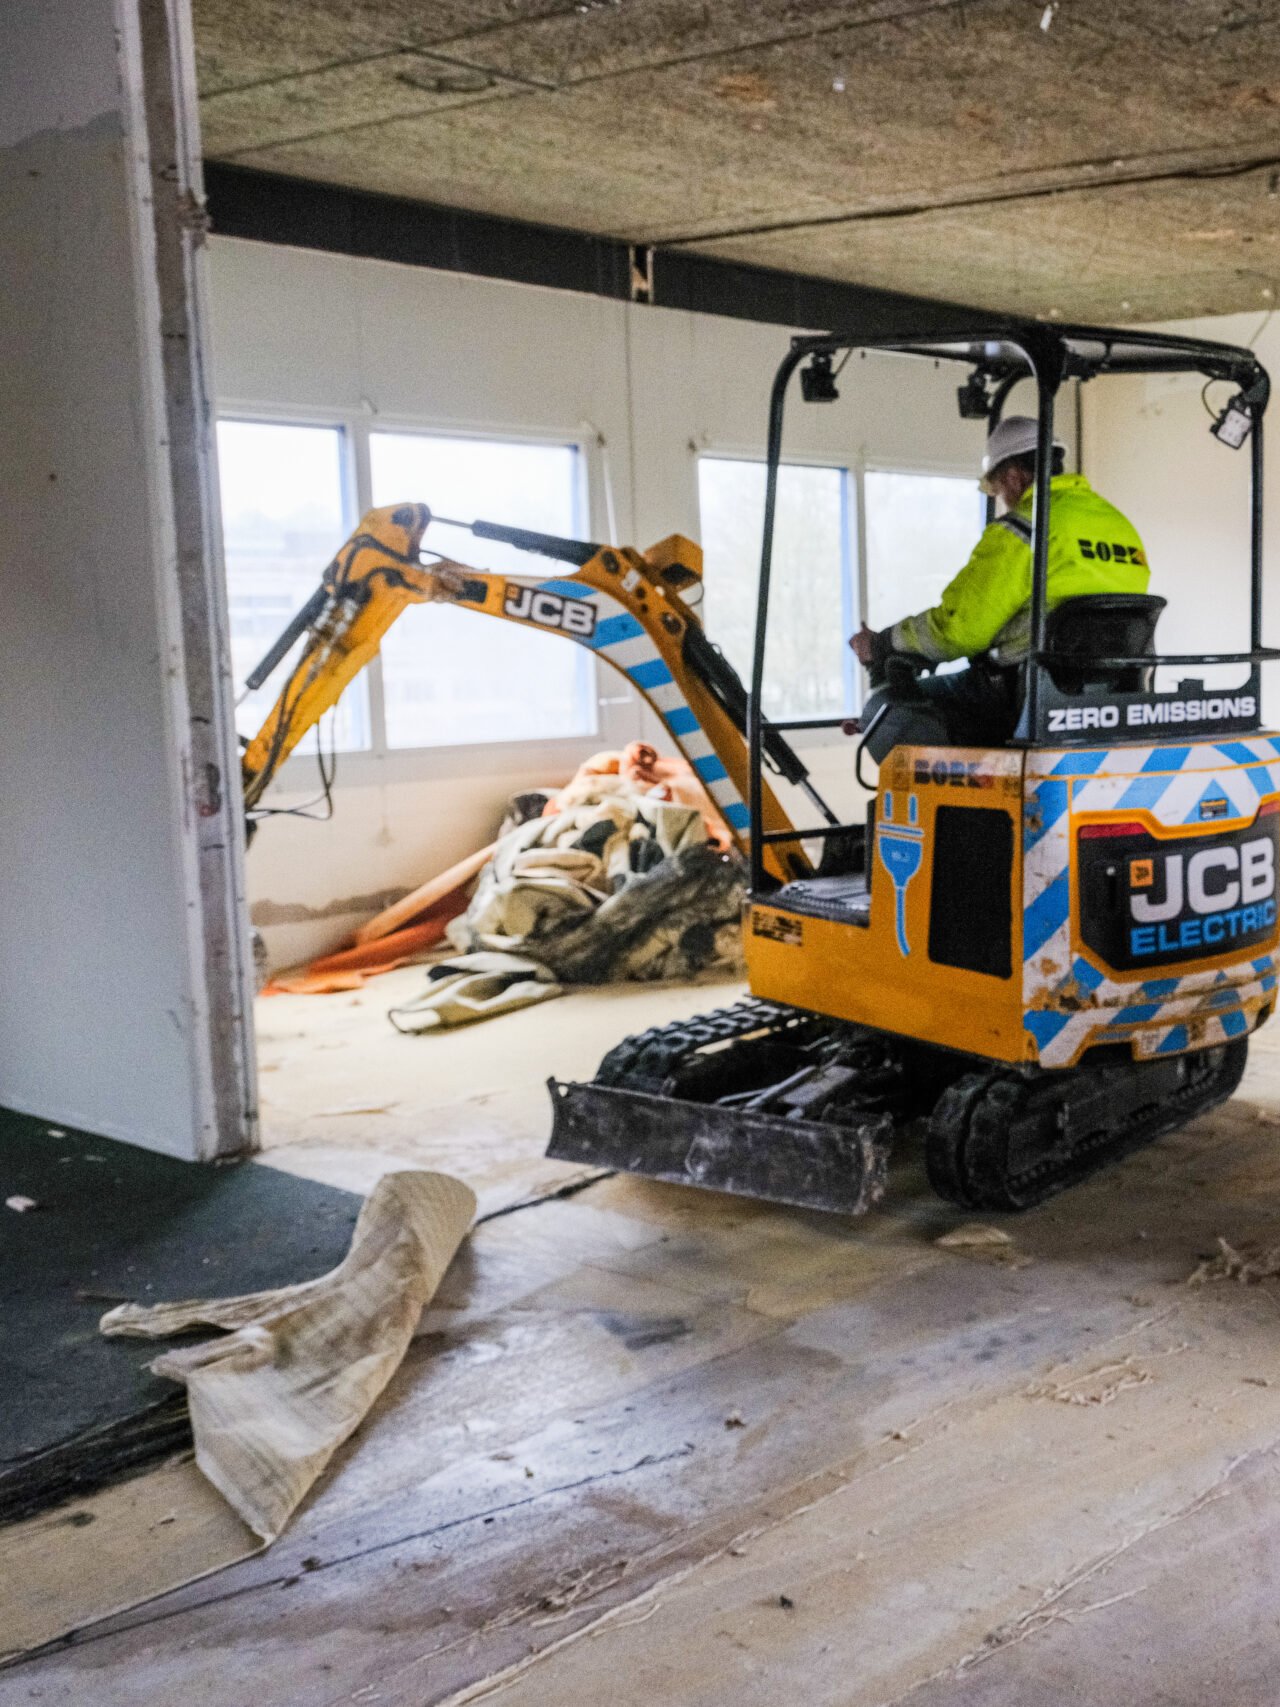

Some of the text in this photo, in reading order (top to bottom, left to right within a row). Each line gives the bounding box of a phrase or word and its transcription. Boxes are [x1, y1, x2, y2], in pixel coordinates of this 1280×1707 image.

[505, 588, 595, 635] JCB
[1048, 696, 1256, 732] ZERO EMISSIONS
[1130, 837, 1275, 923] JCB
[1131, 900, 1276, 956] ELECTRIC
